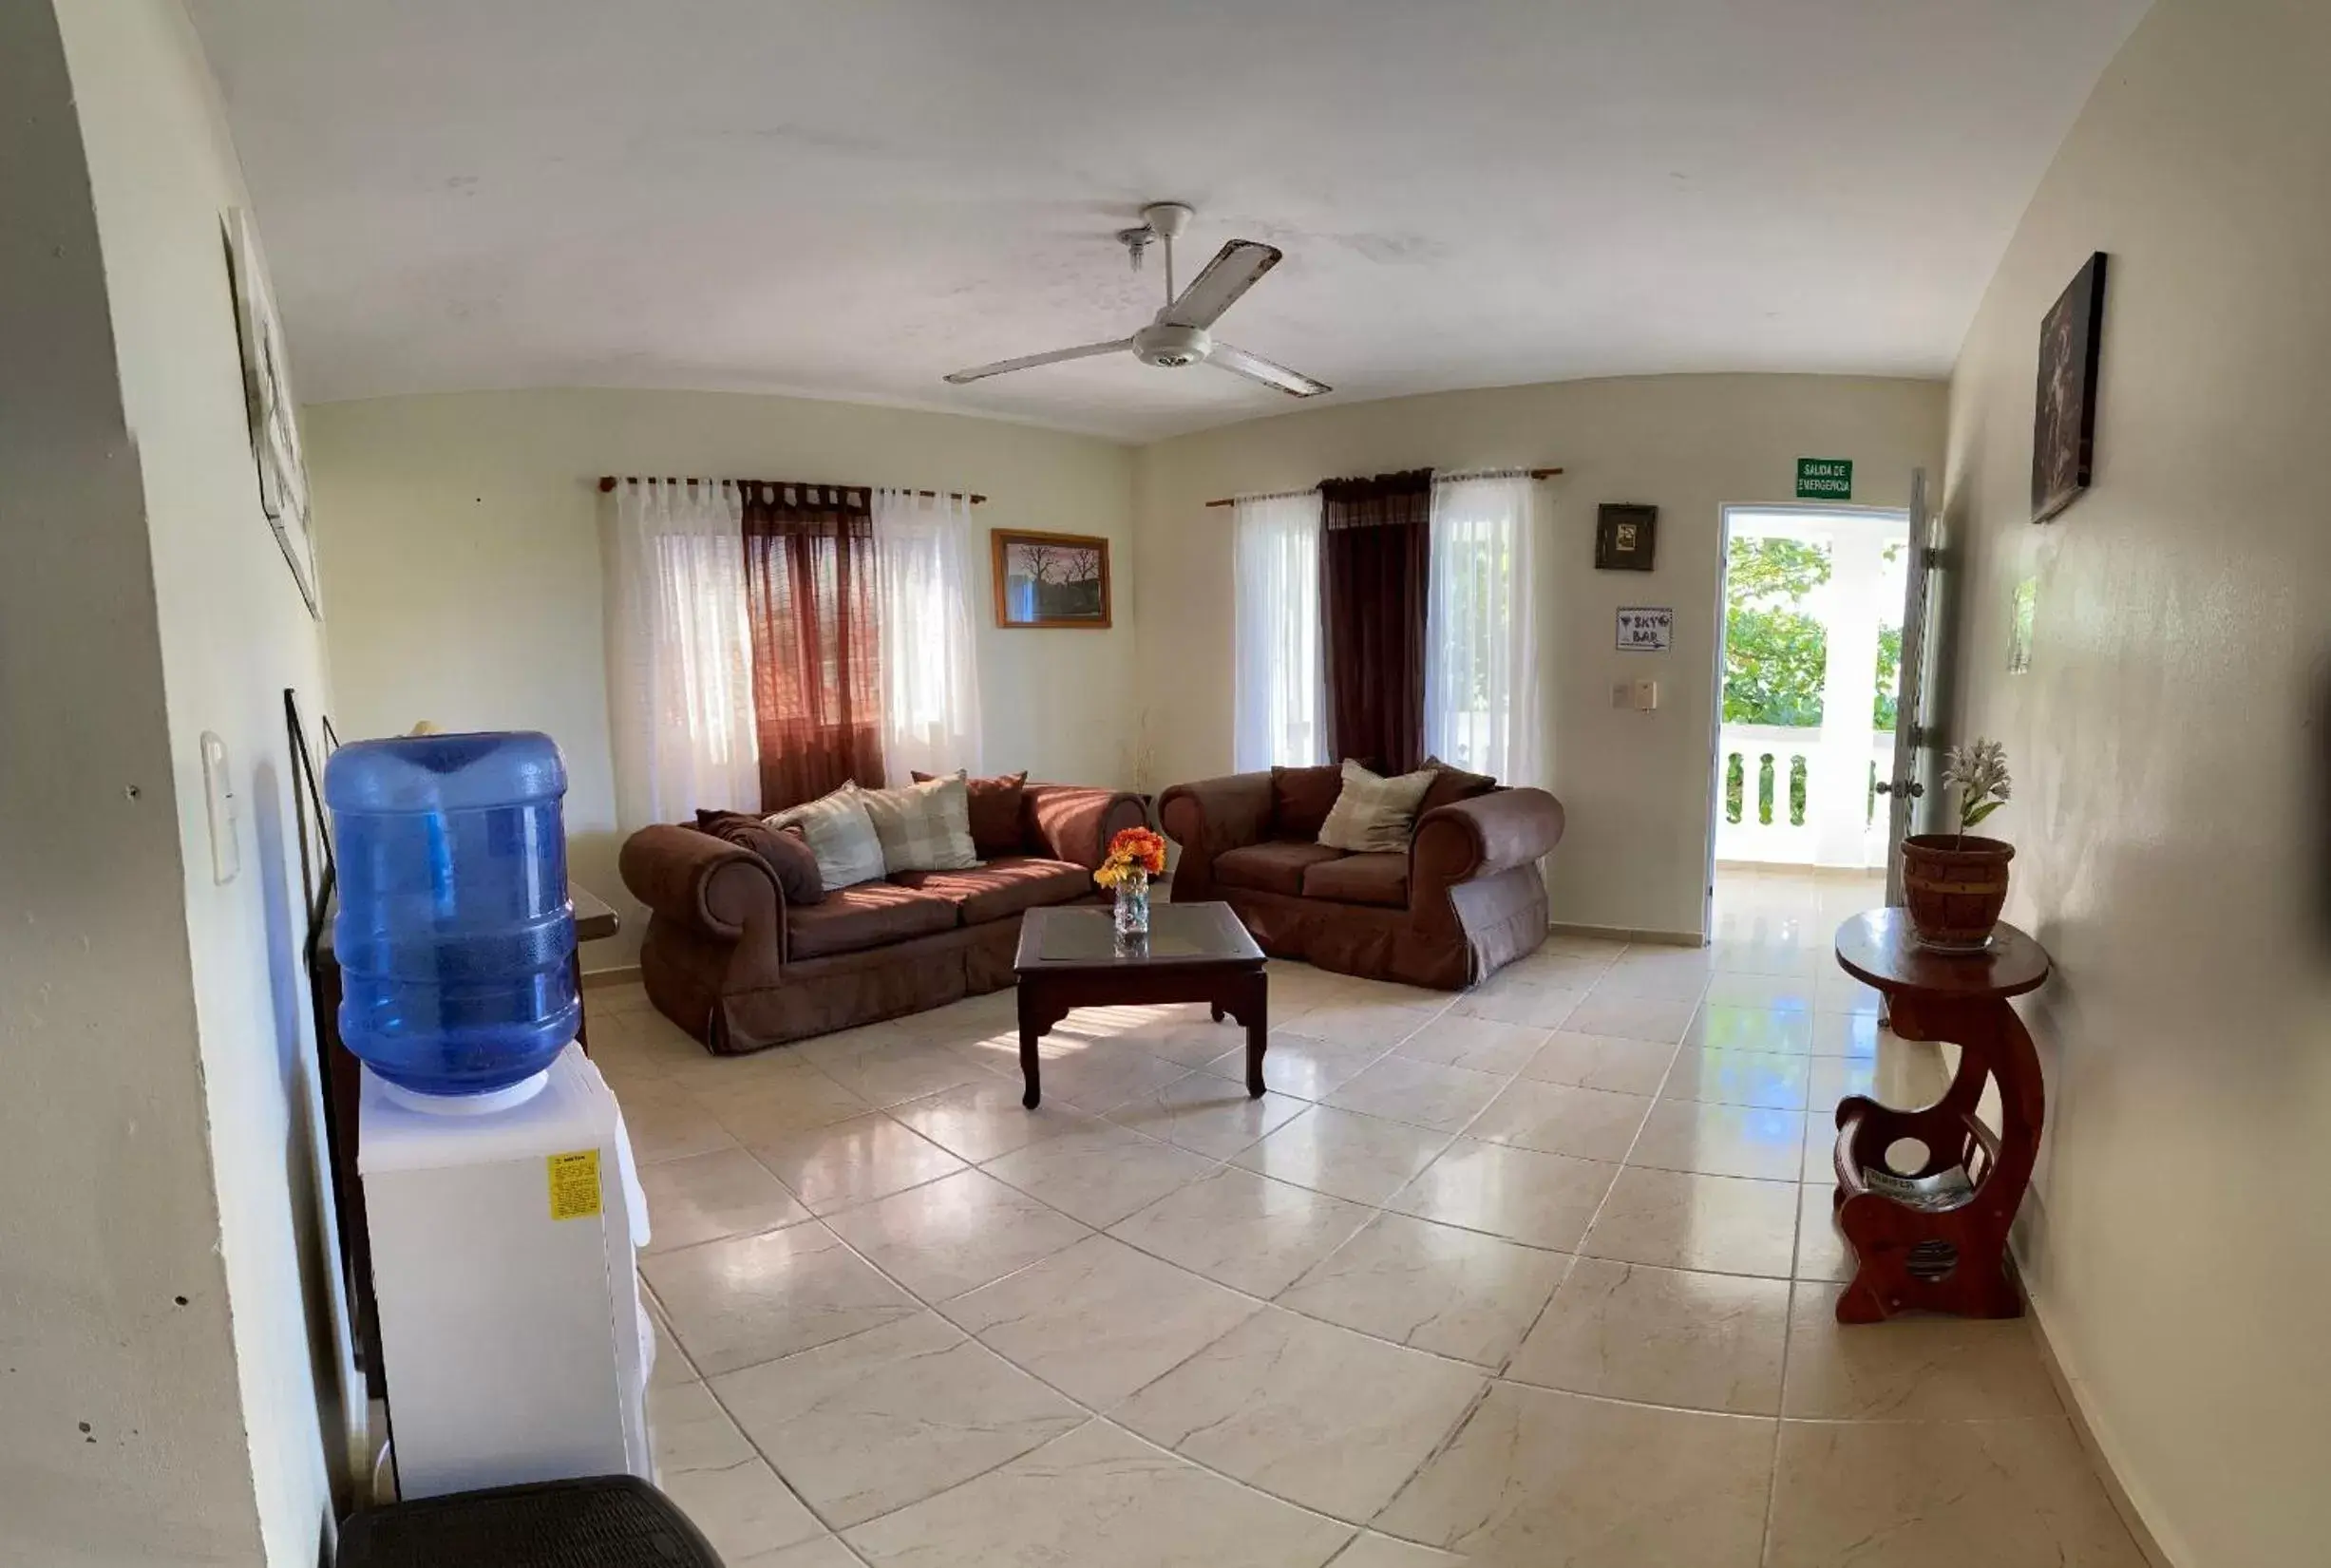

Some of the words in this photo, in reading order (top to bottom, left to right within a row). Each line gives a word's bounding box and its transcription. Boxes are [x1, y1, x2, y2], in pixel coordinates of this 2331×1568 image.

[1804, 463, 1832, 476] SALIDA
[1833, 464, 1847, 476] DE
[1798, 478, 1849, 492] EMERGENCIA
[1634, 615, 1658, 629] SKY
[1633, 630, 1658, 643] BAR
